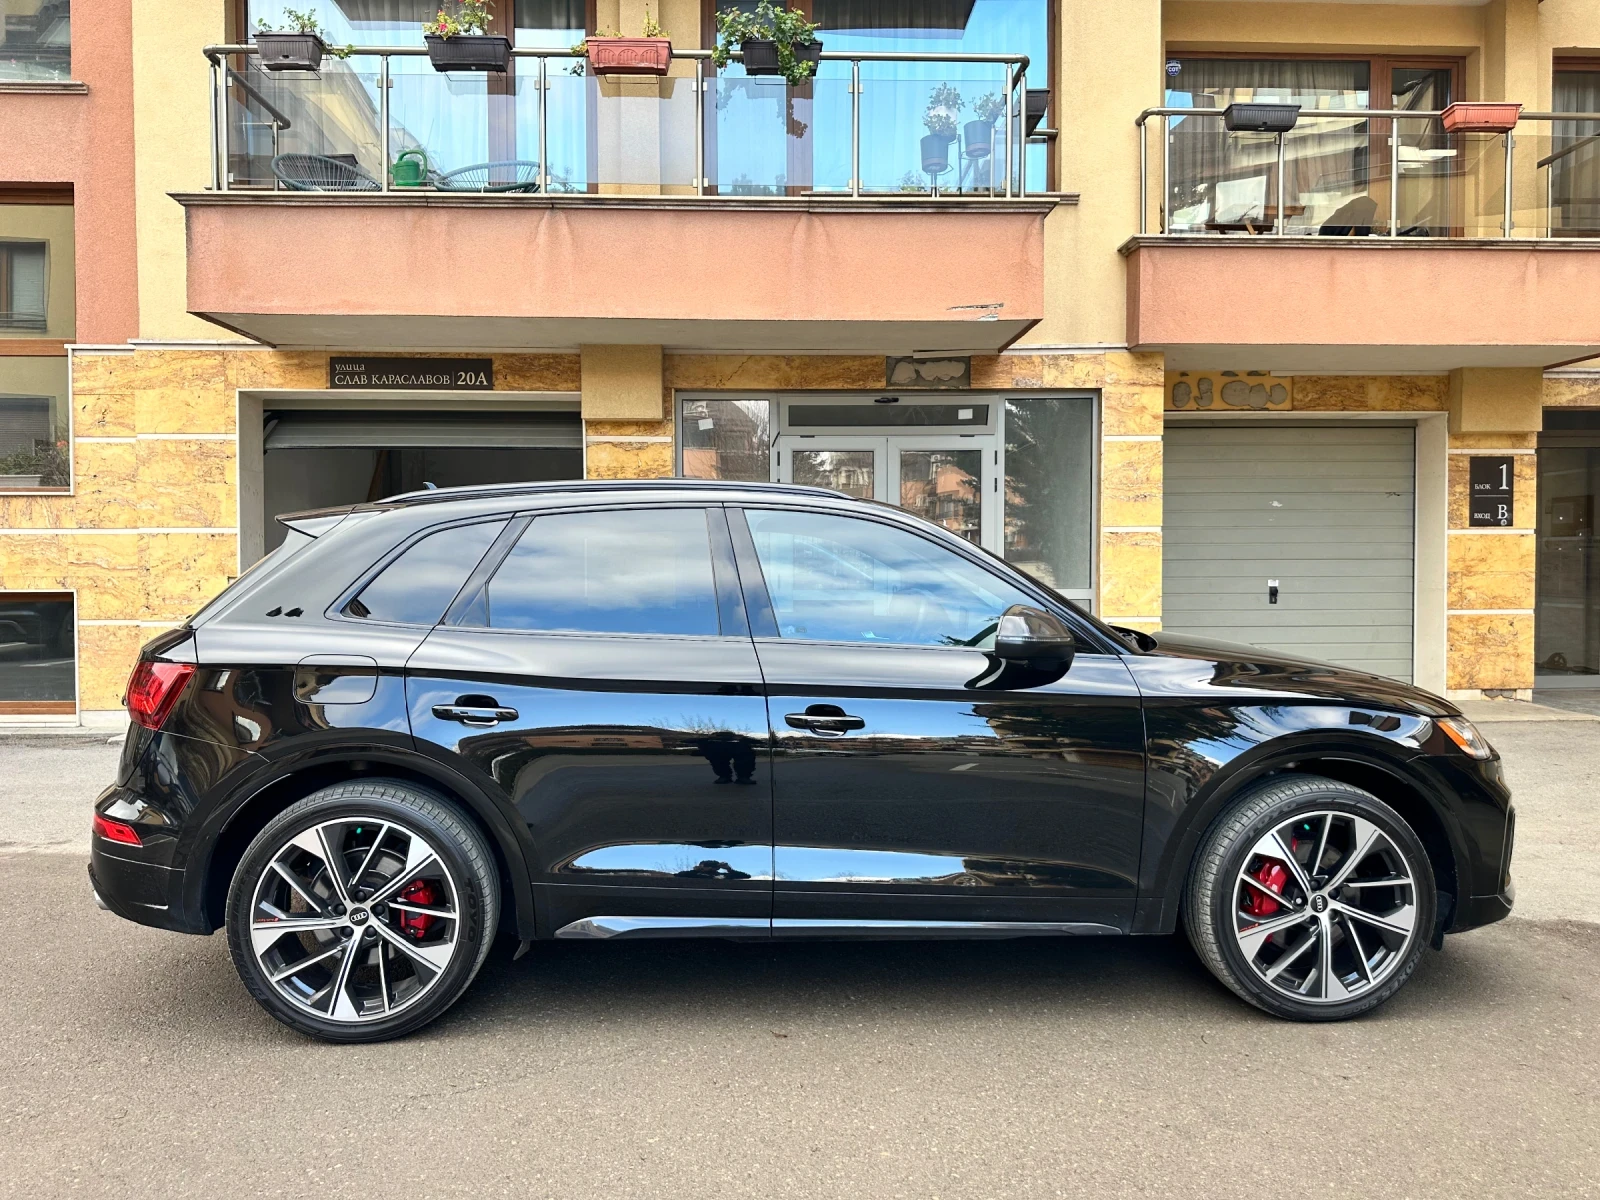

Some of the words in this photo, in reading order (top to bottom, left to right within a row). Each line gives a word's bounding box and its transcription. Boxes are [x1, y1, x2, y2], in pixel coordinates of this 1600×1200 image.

[335, 363, 365, 373] улица
[334, 374, 368, 385] СЛАВ
[371, 374, 450, 385] КАРАСЛАВОВ
[1498, 463, 1509, 490] 1
[1496, 504, 1508, 519] В
